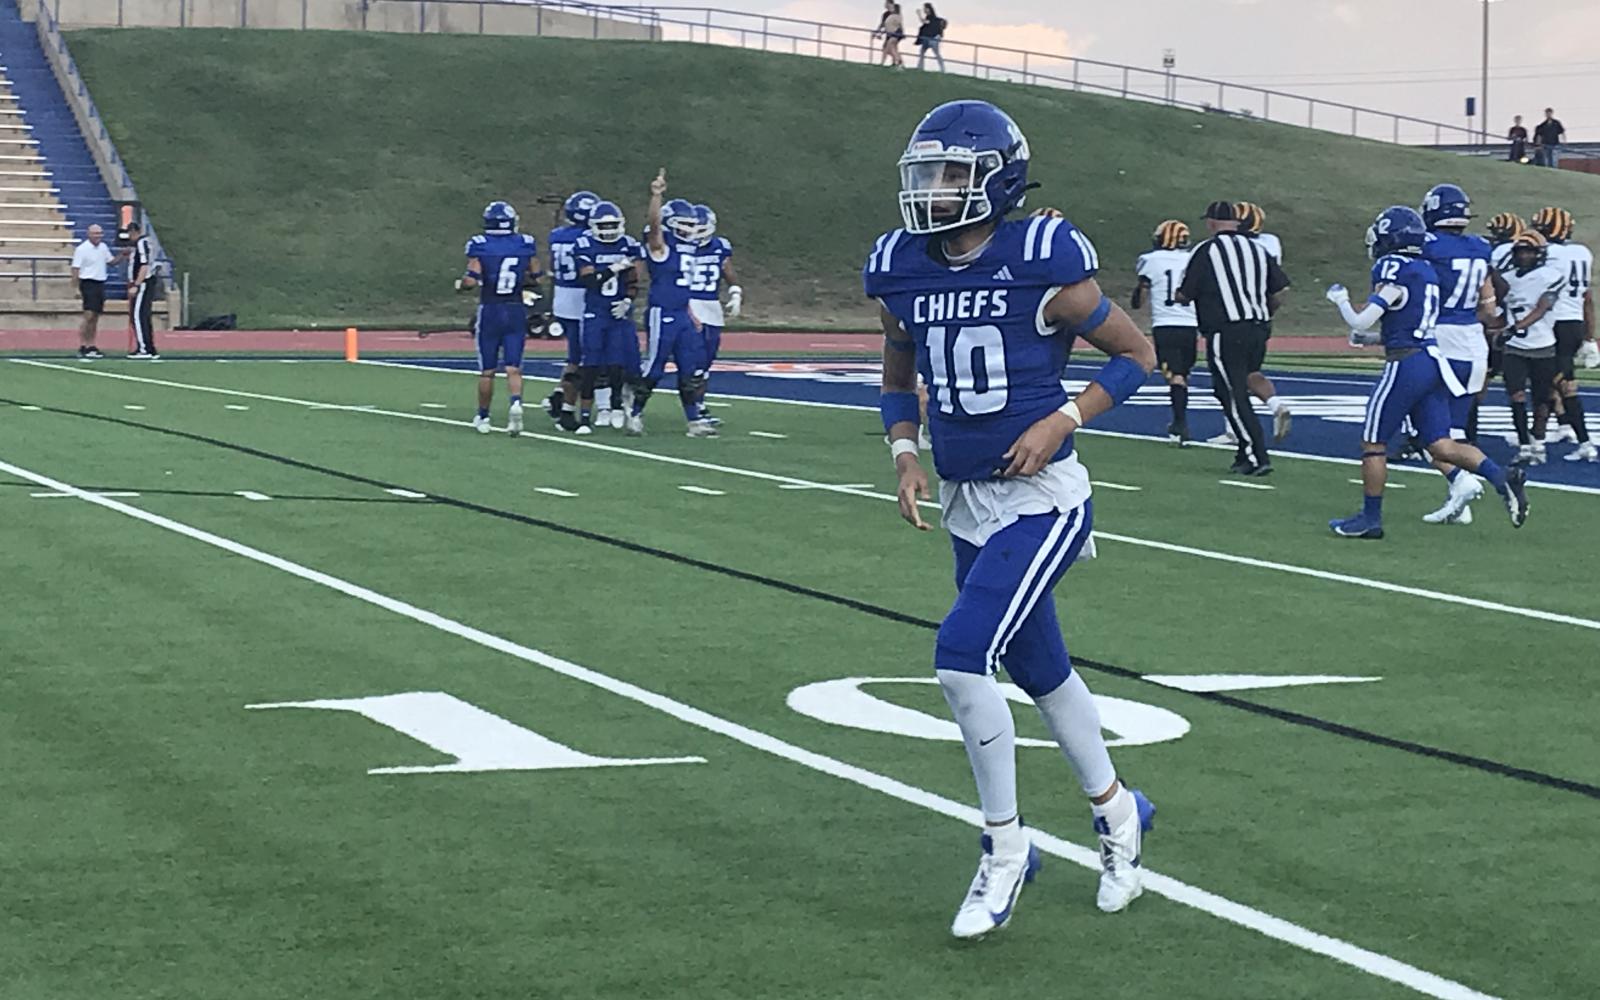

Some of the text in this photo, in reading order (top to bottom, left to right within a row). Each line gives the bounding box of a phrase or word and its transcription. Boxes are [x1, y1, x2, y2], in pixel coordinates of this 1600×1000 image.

[496, 257, 519, 294] 6
[1380, 260, 1400, 280] 12
[1443, 258, 1488, 310] 70
[913, 289, 1008, 324] CHIEFS
[925, 325, 1009, 416] 10
